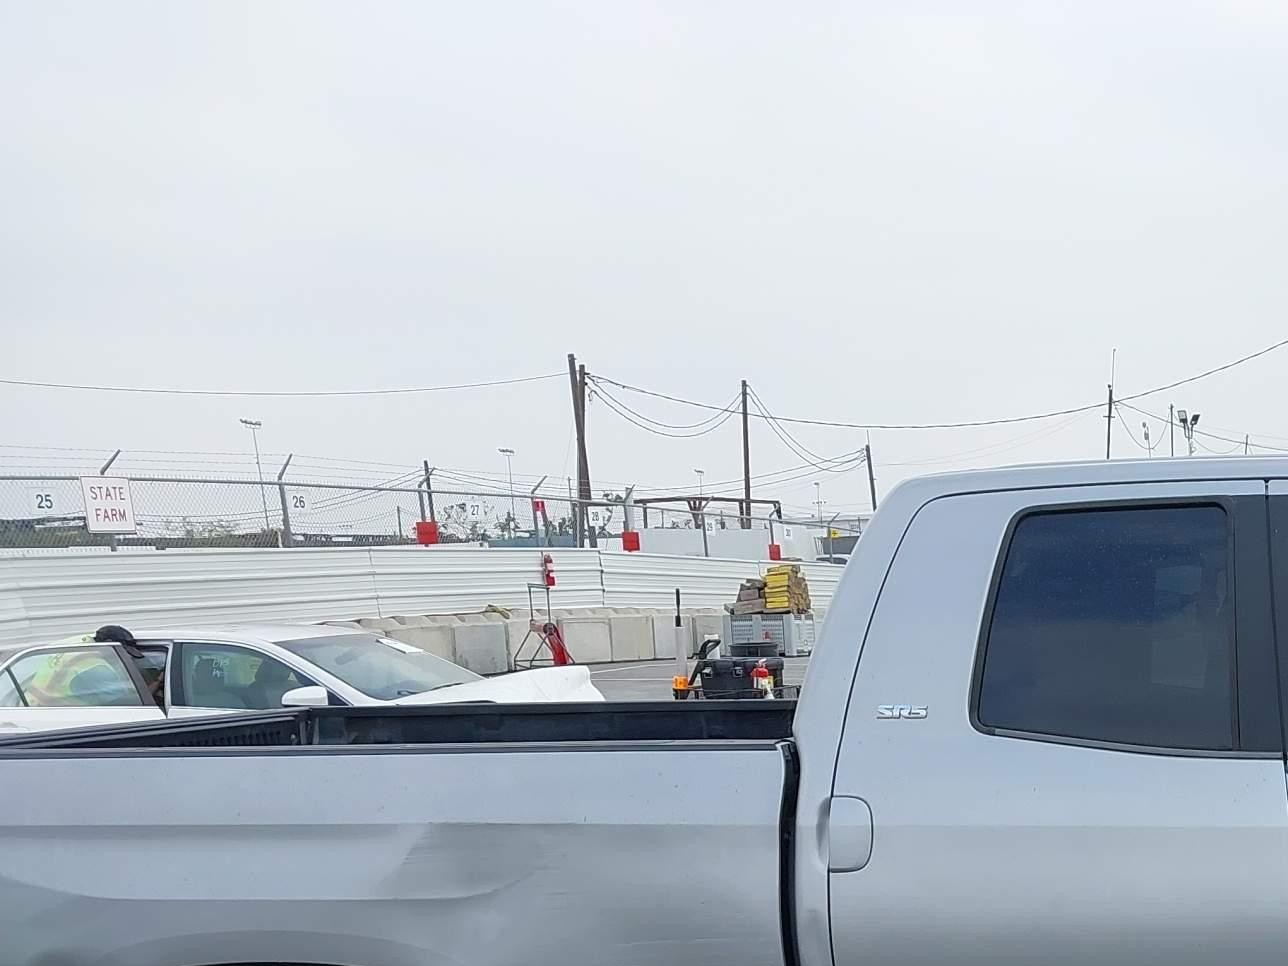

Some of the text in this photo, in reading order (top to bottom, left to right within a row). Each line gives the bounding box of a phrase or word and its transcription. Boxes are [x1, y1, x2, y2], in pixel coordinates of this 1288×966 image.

[90, 486, 126, 501] STATE
[35, 494, 54, 509] 25
[292, 495, 306, 509] 26
[95, 508, 128, 522] FARM
[470, 504, 480, 516] 27
[591, 511, 600, 522] 28
[876, 704, 929, 720] SR5
